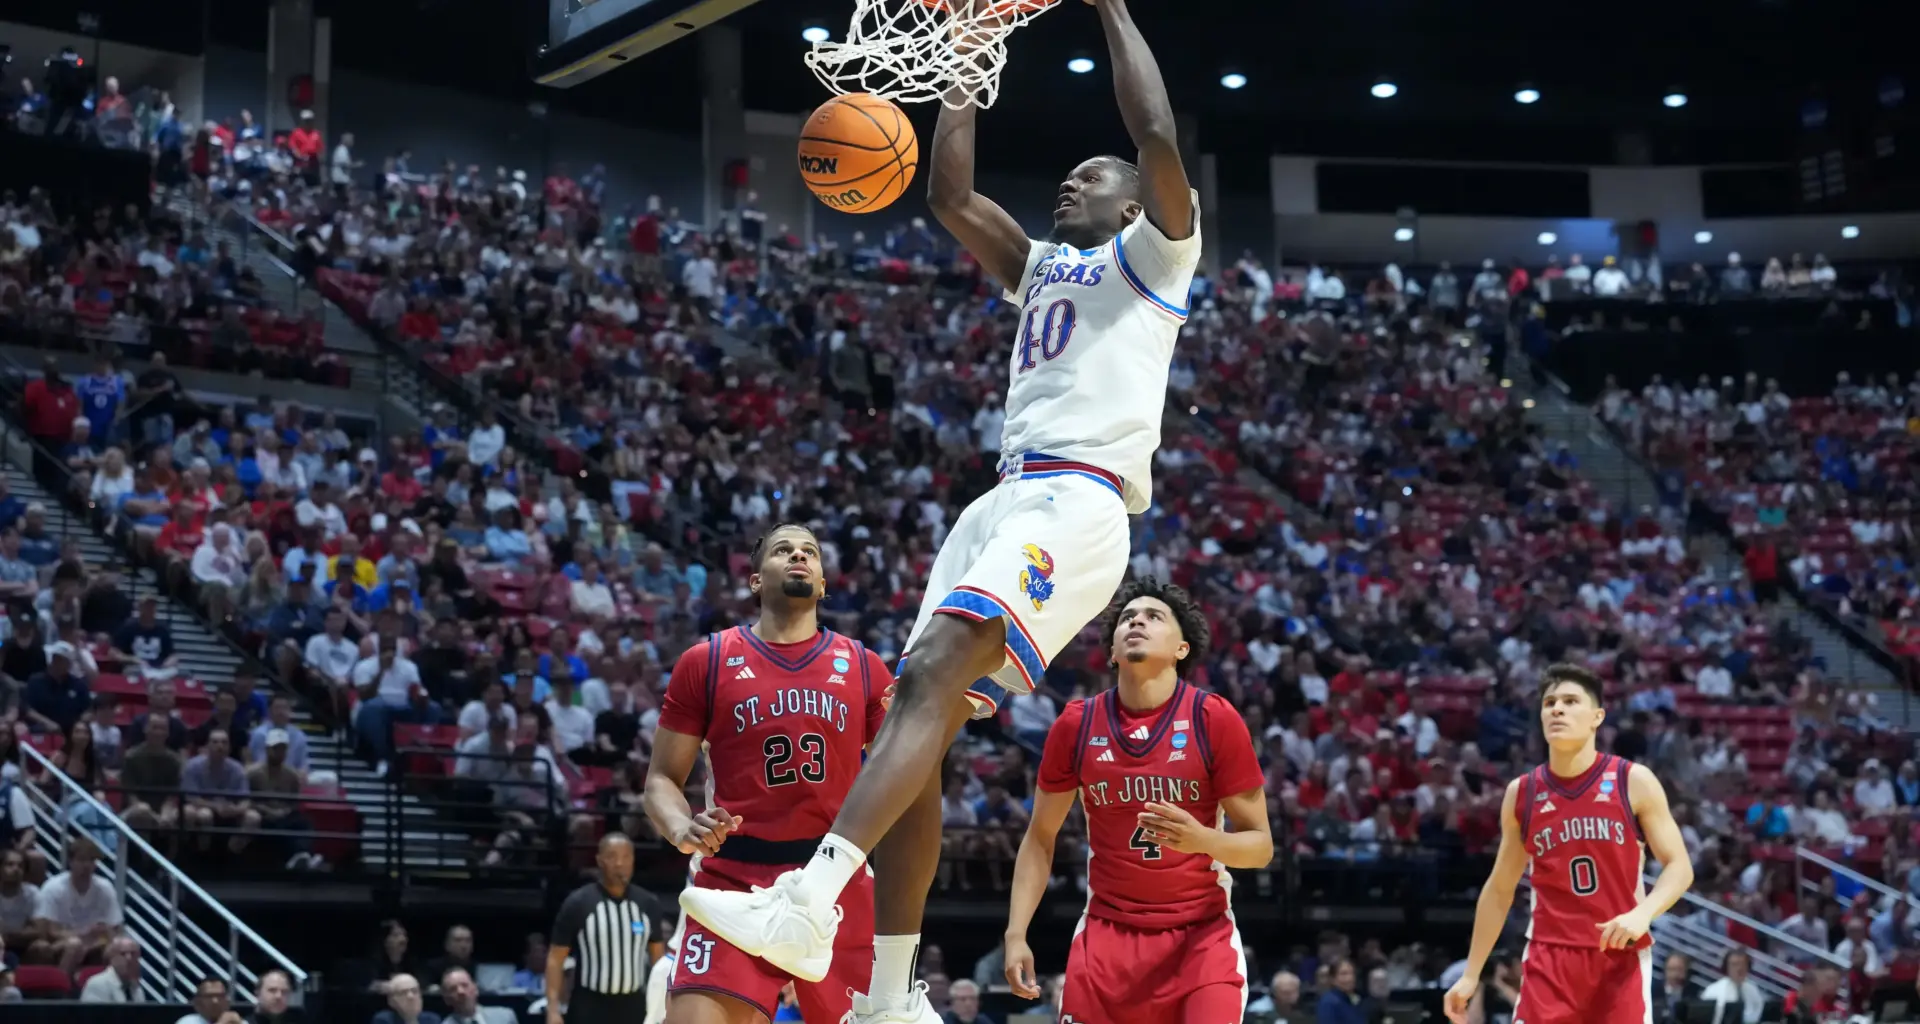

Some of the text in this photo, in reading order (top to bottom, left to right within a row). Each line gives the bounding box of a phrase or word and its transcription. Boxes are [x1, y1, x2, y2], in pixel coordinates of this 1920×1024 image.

[1018, 298, 1076, 374] 40
[734, 688, 848, 733] ST. JOHN'S
[763, 733, 826, 787] 23
[1089, 776, 1200, 806] ST. JOHN'S
[1129, 826, 1162, 860] 4
[1533, 817, 1625, 857] ST. JOHN'S
[1569, 855, 1598, 896] 0
[684, 933, 716, 975] SJ
